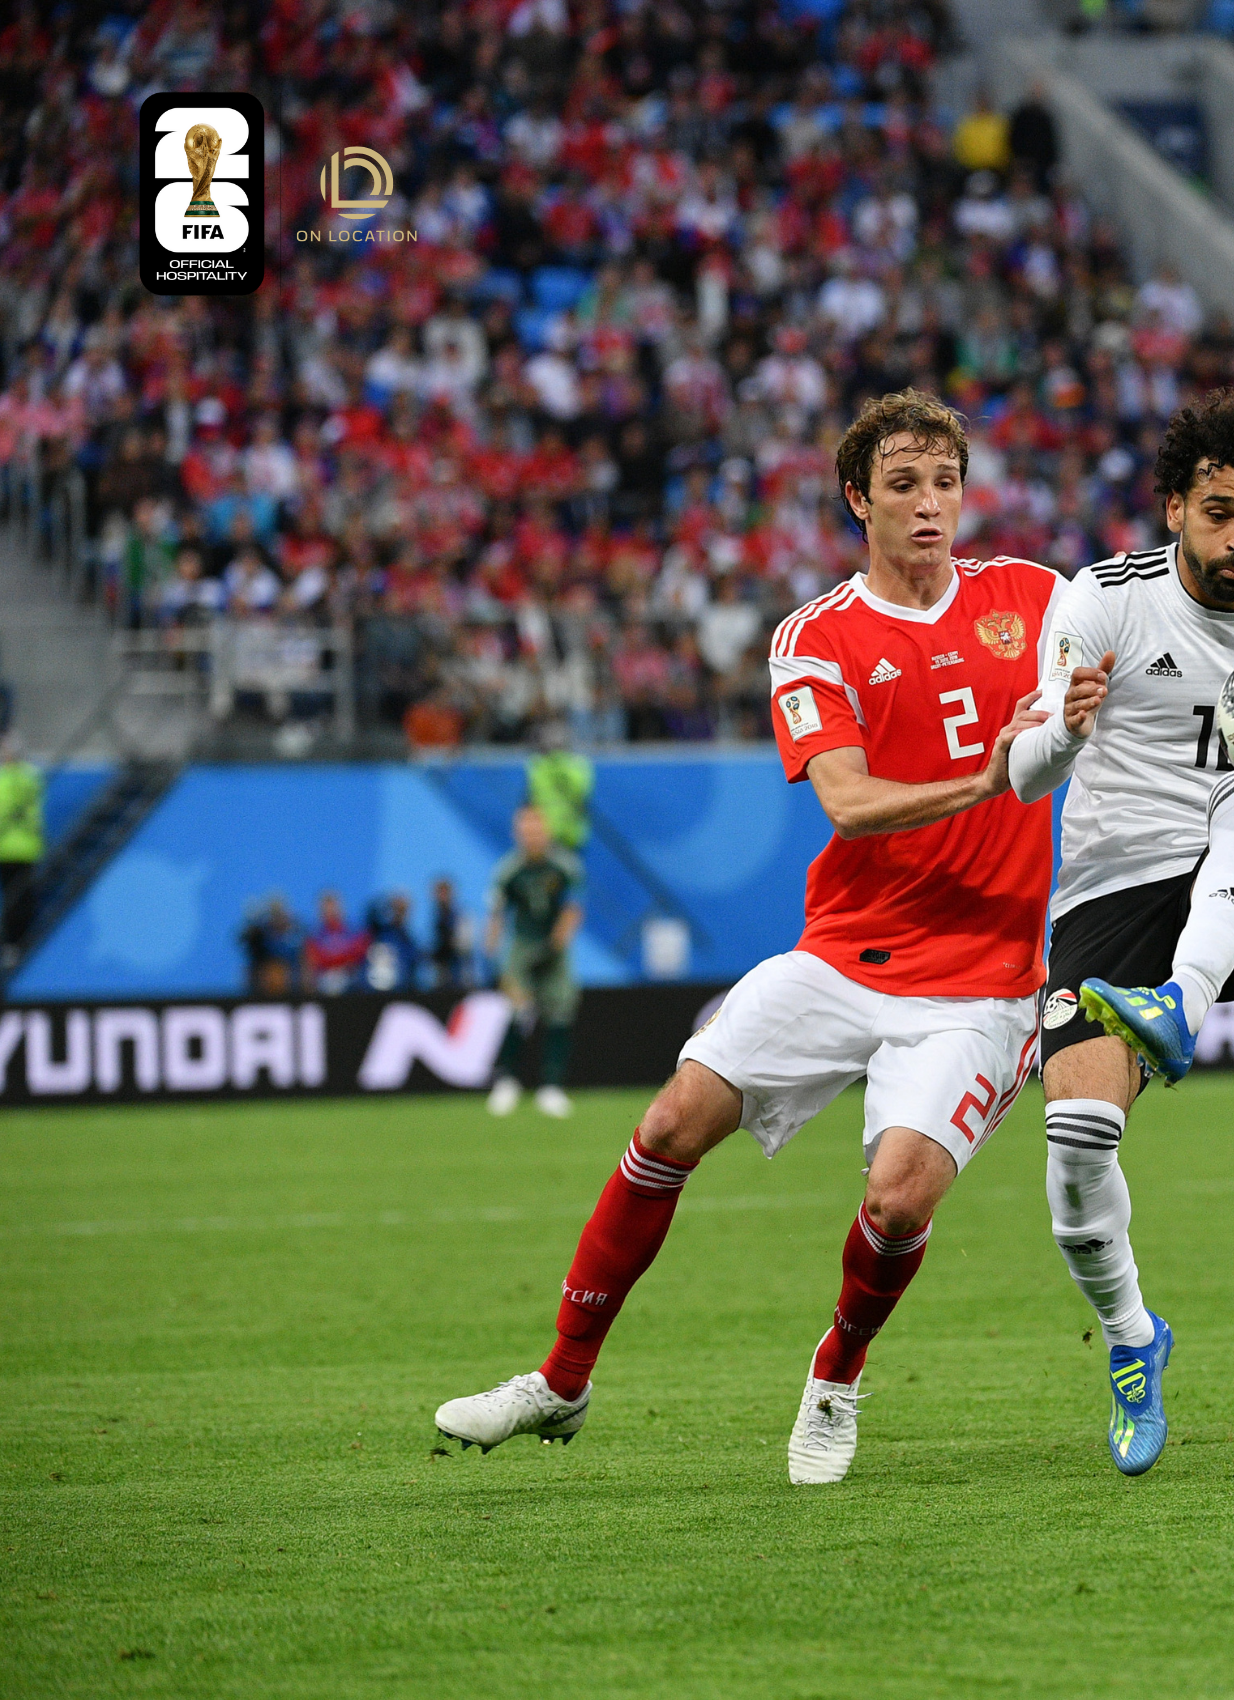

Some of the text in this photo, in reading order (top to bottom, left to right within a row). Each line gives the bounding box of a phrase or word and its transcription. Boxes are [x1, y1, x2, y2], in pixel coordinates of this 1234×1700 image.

[868, 668, 902, 686] adidas
[1145, 668, 1183, 677] adidas
[938, 686, 985, 760] 2
[949, 1072, 998, 1145] 2
